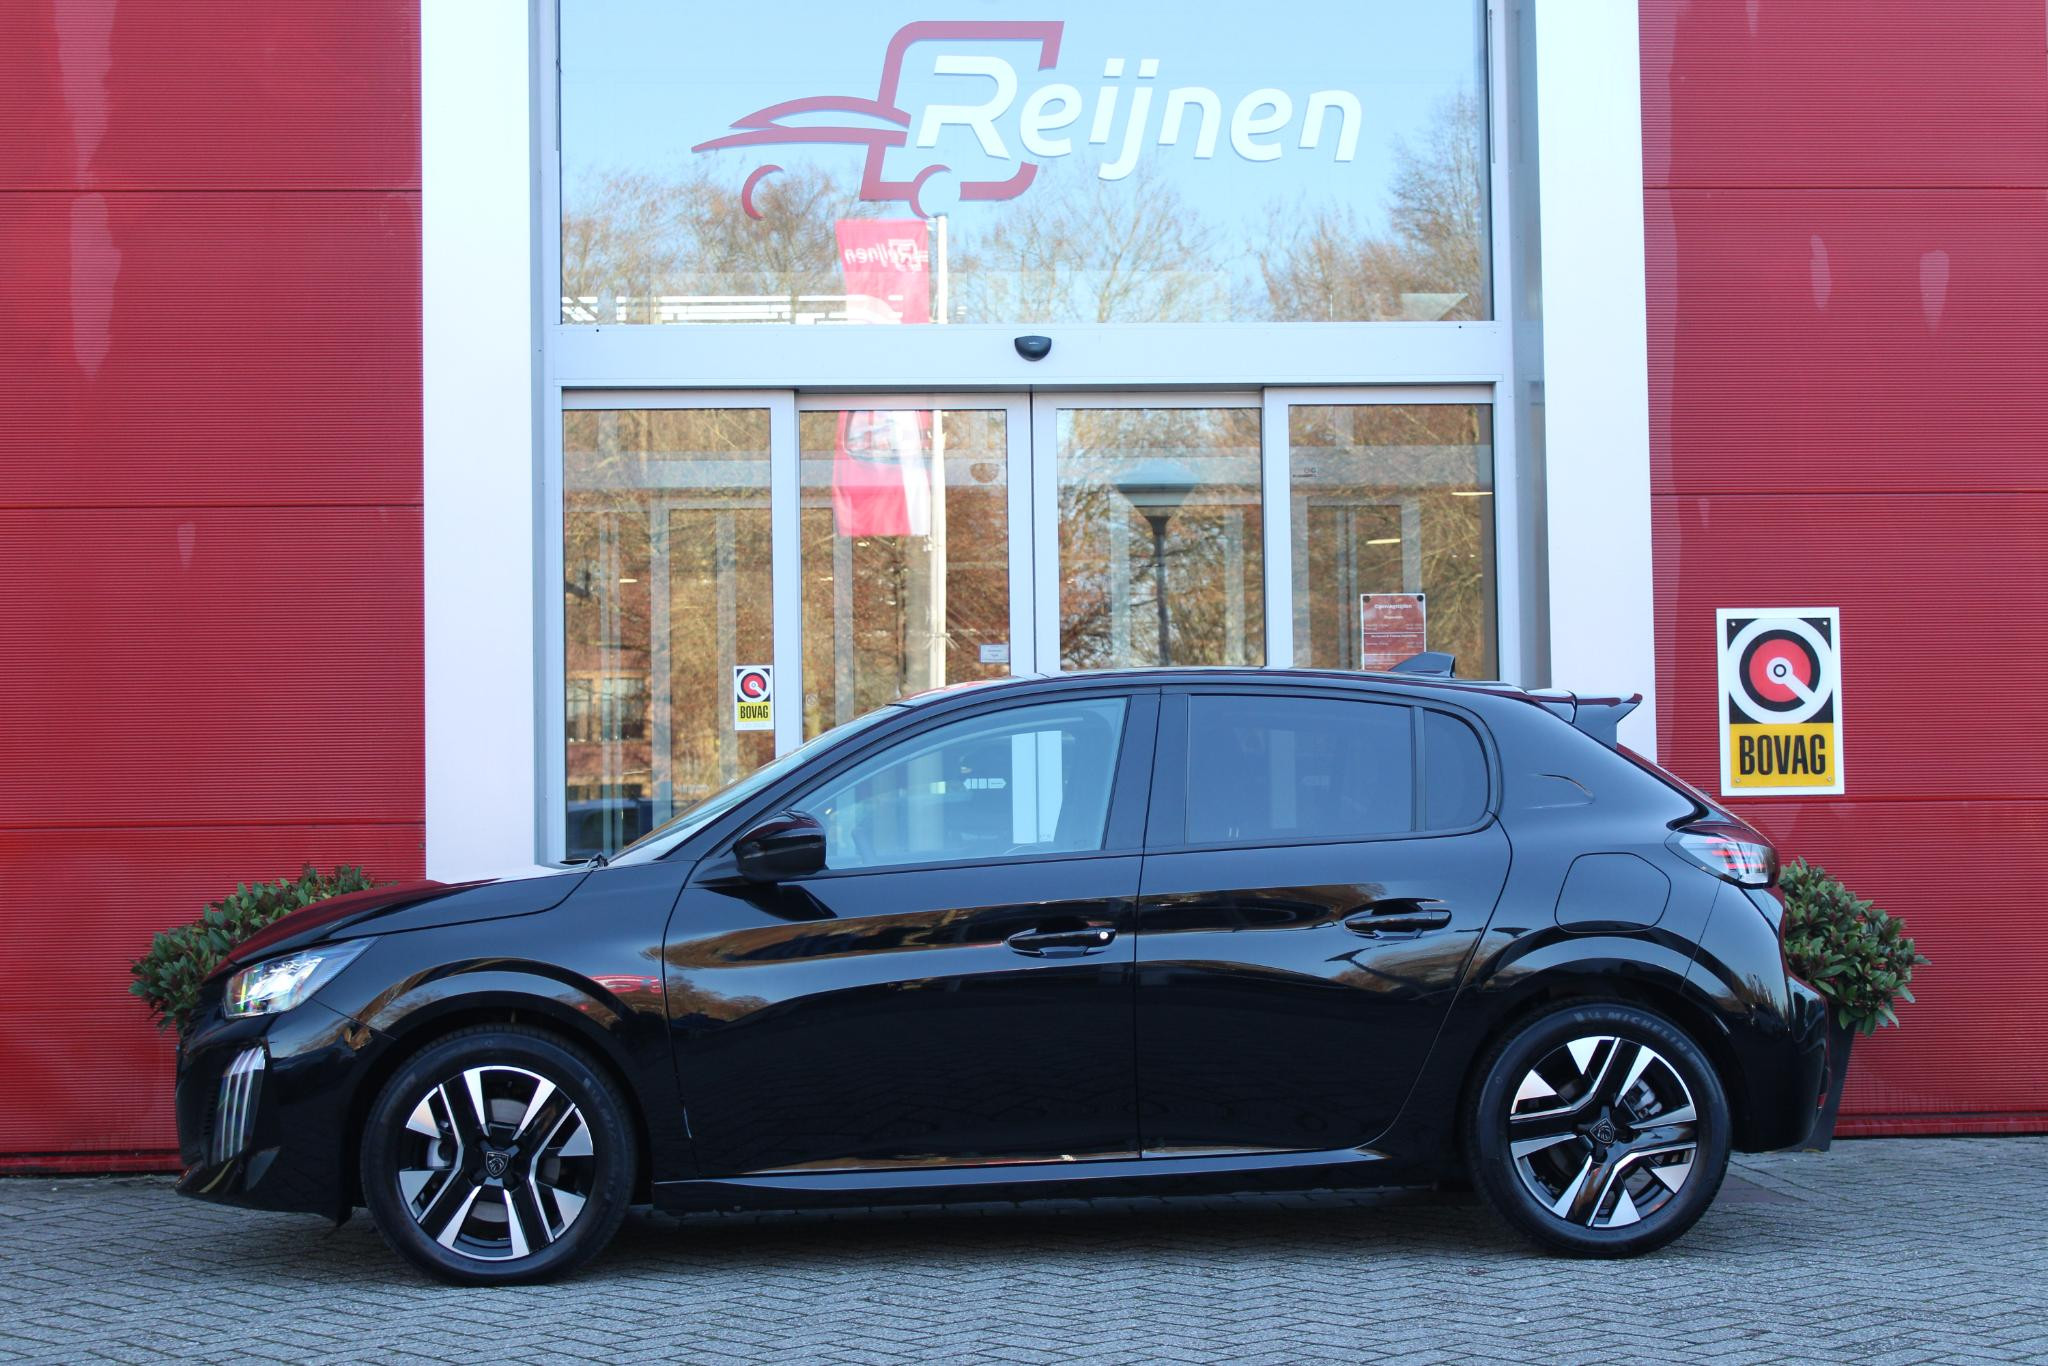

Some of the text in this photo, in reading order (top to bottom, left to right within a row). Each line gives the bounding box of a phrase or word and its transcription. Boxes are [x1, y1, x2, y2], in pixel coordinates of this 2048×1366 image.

[916, 55, 1362, 181] Reijnen
[740, 705, 769, 719] BOVAG
[1739, 734, 1826, 776] BOVAG
[1607, 1011, 1688, 1052] MICHELIN
